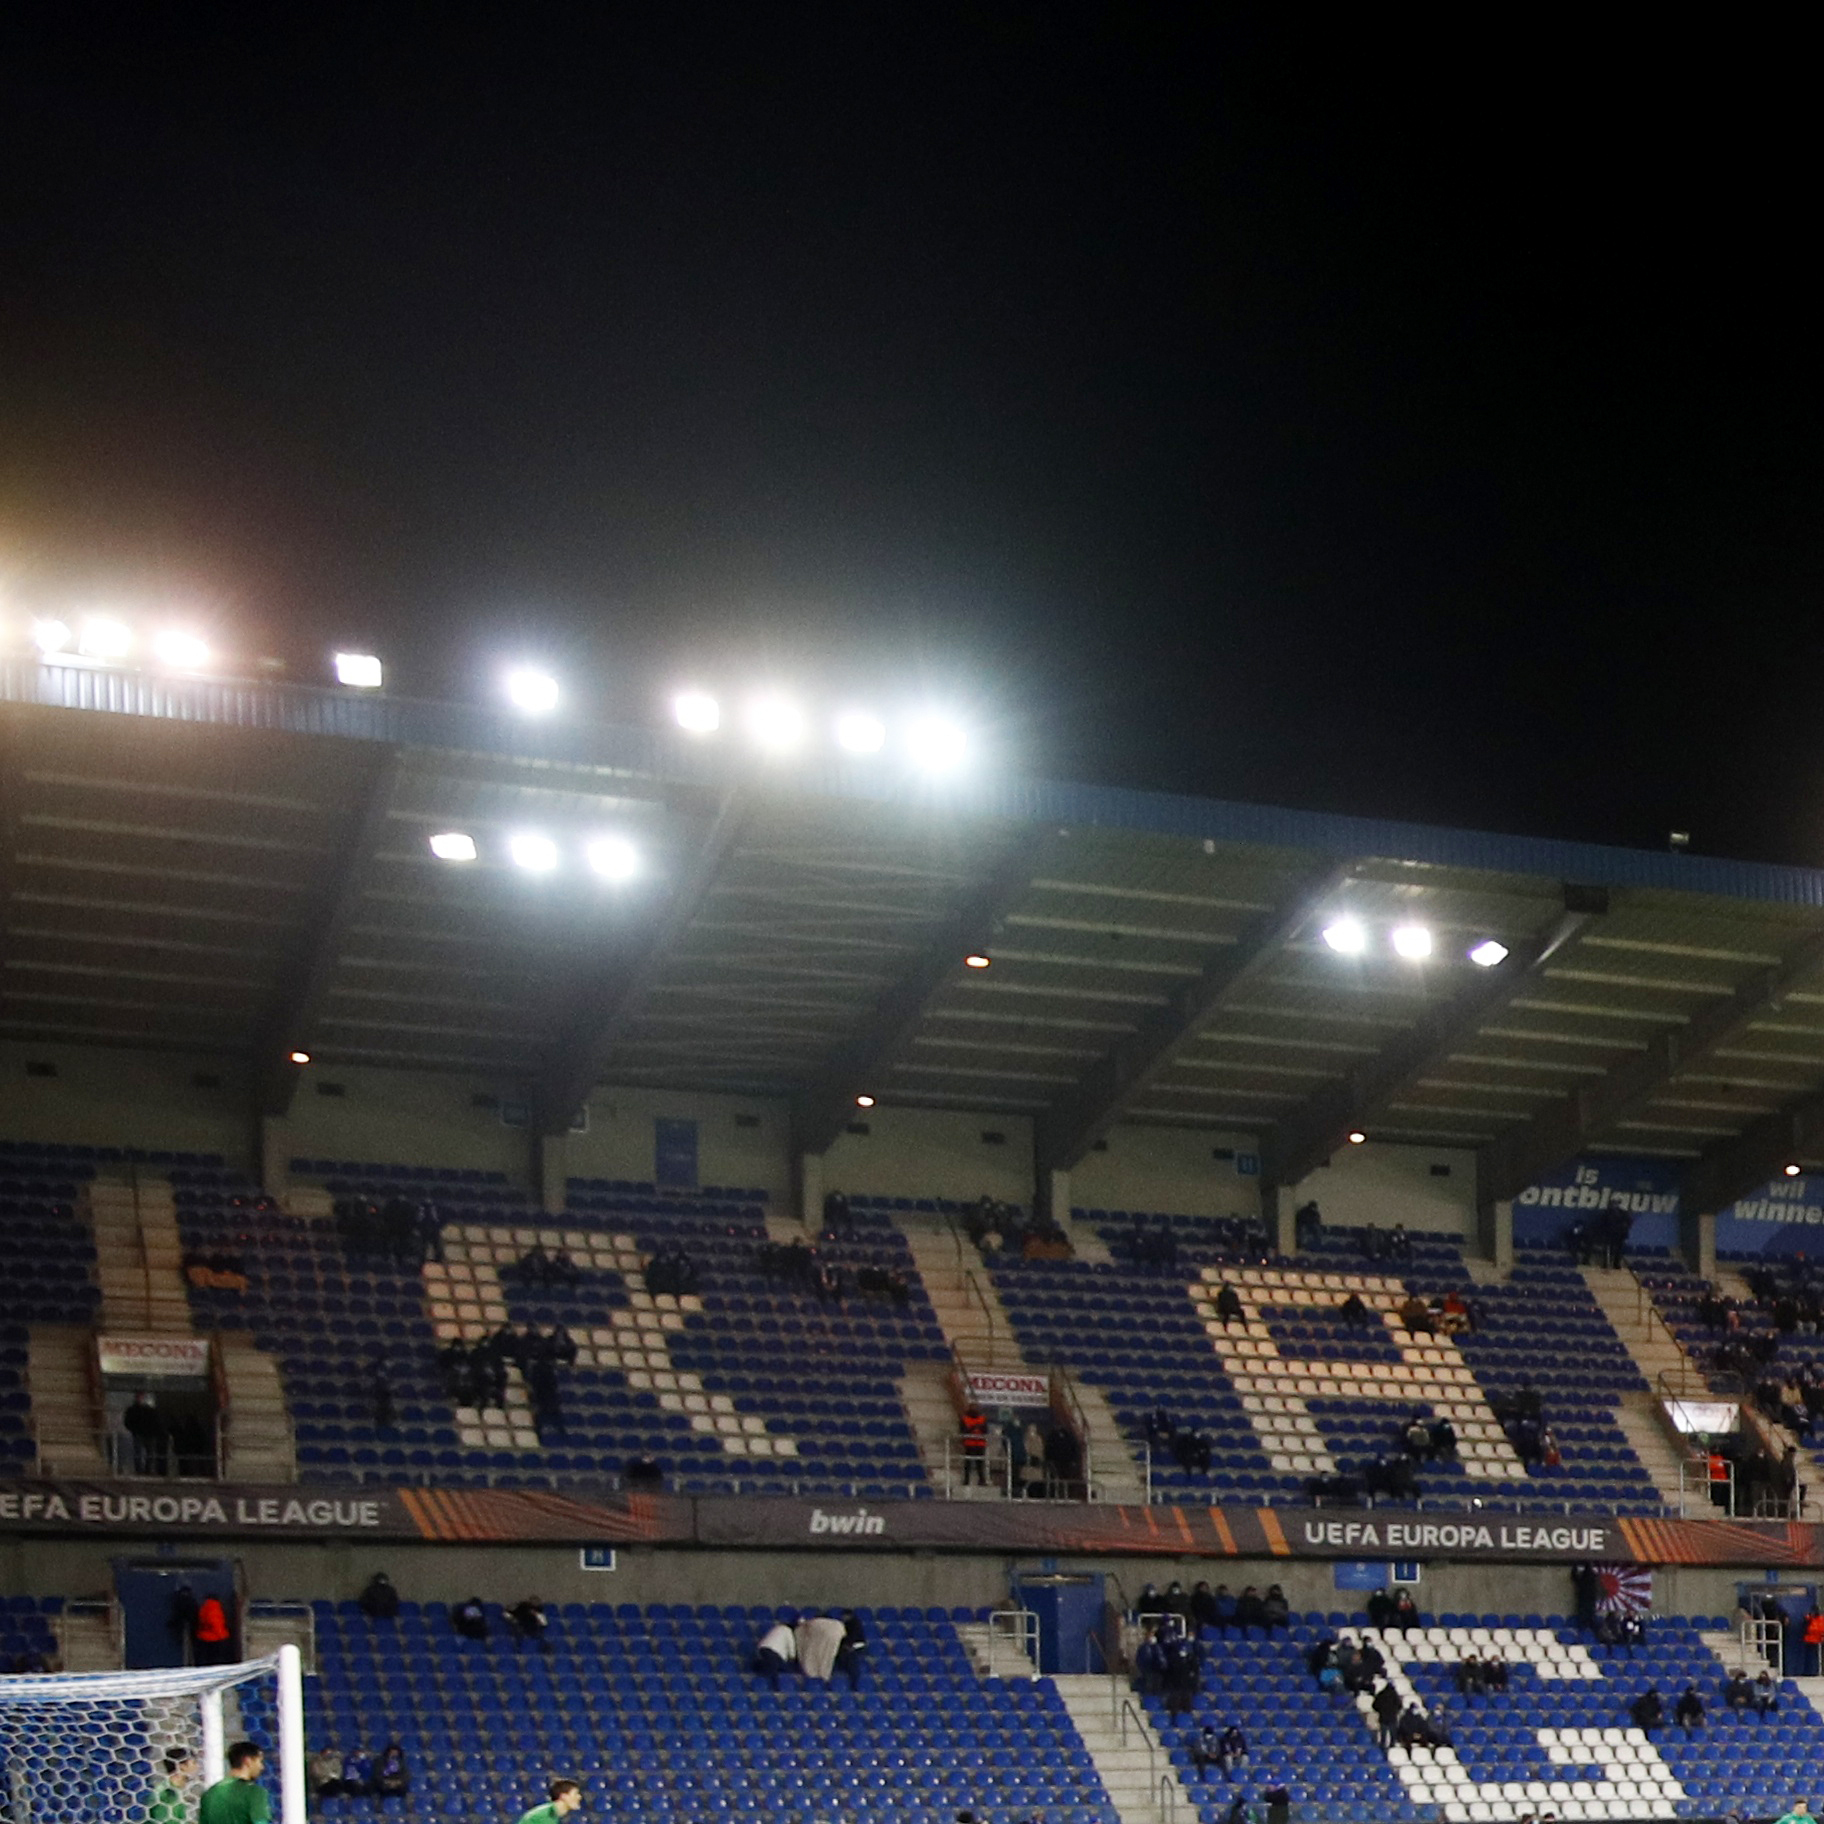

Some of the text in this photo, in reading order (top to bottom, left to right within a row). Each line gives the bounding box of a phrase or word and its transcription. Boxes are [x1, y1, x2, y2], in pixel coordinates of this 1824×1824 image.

[0, 1494, 380, 1527] EFA EUROPA LEAGUE
[809, 1508, 884, 1535] bwin
[1305, 1521, 1605, 1550] UEFA EUROPA LEAGUE
